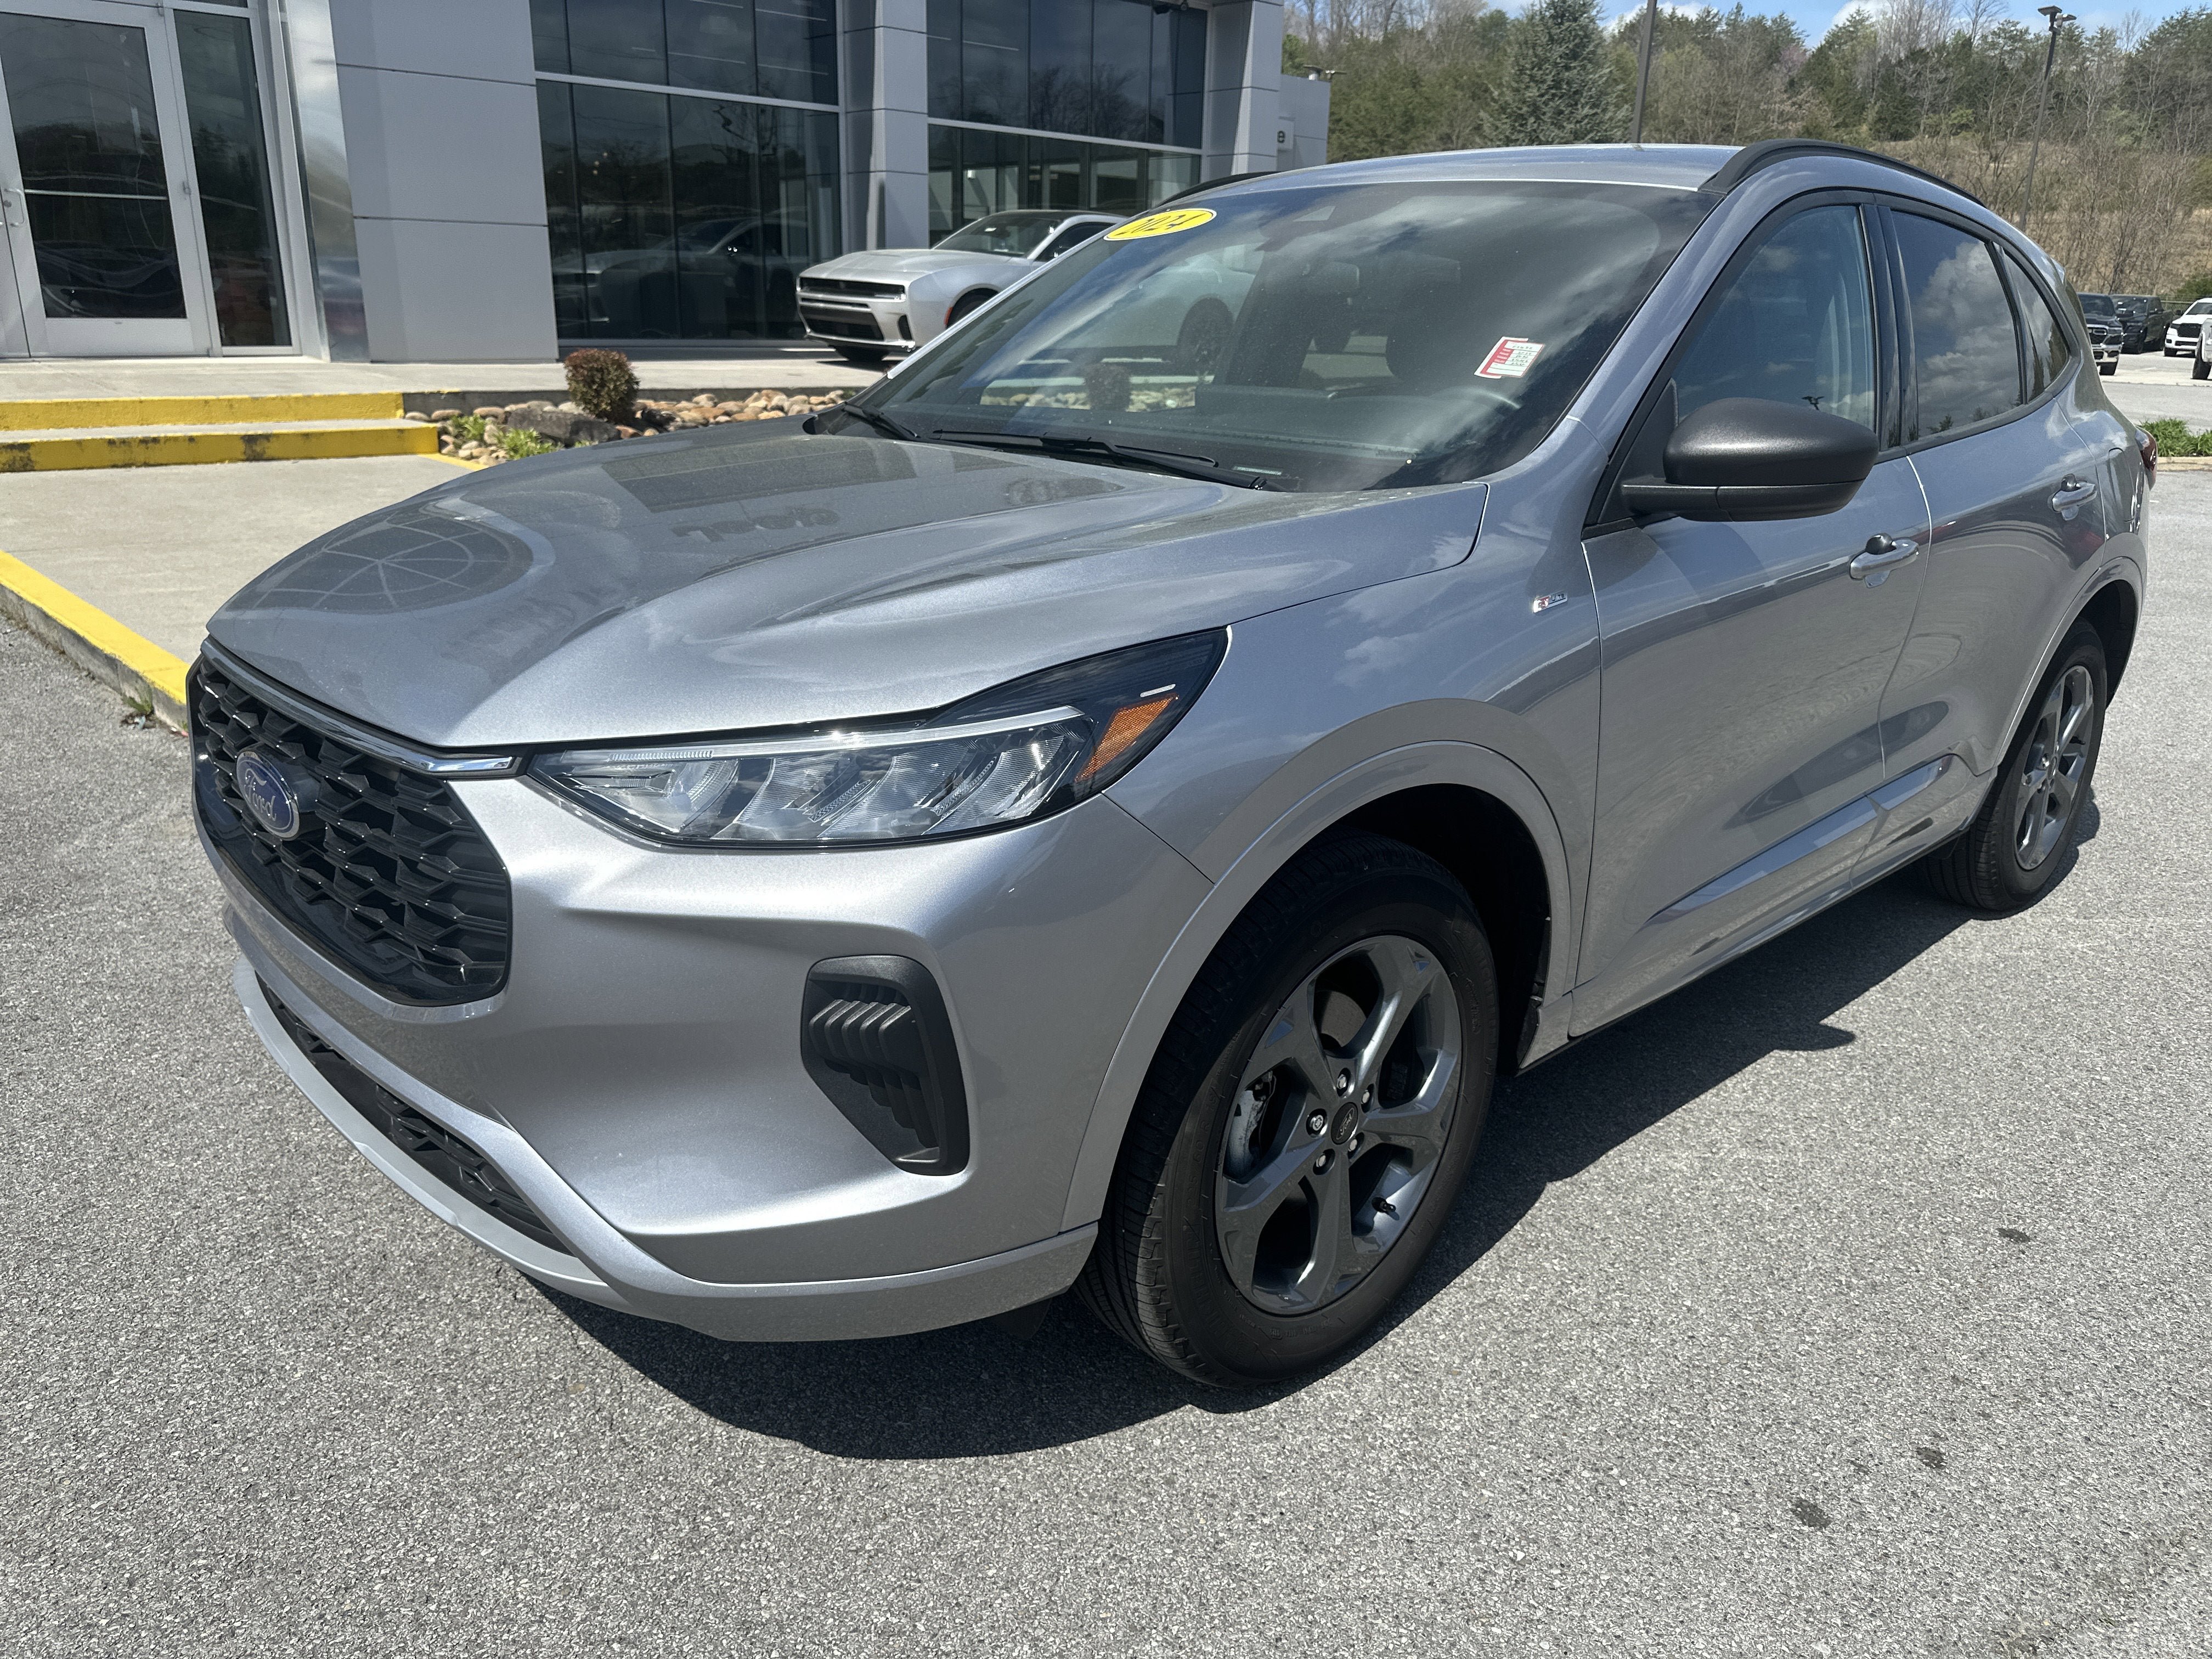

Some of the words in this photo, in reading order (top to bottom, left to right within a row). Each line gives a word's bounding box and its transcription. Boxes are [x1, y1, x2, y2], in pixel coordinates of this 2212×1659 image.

[1114, 213, 1207, 236] 2024
[244, 768, 277, 822] Ford
[1340, 1113, 1352, 1136] Ford
